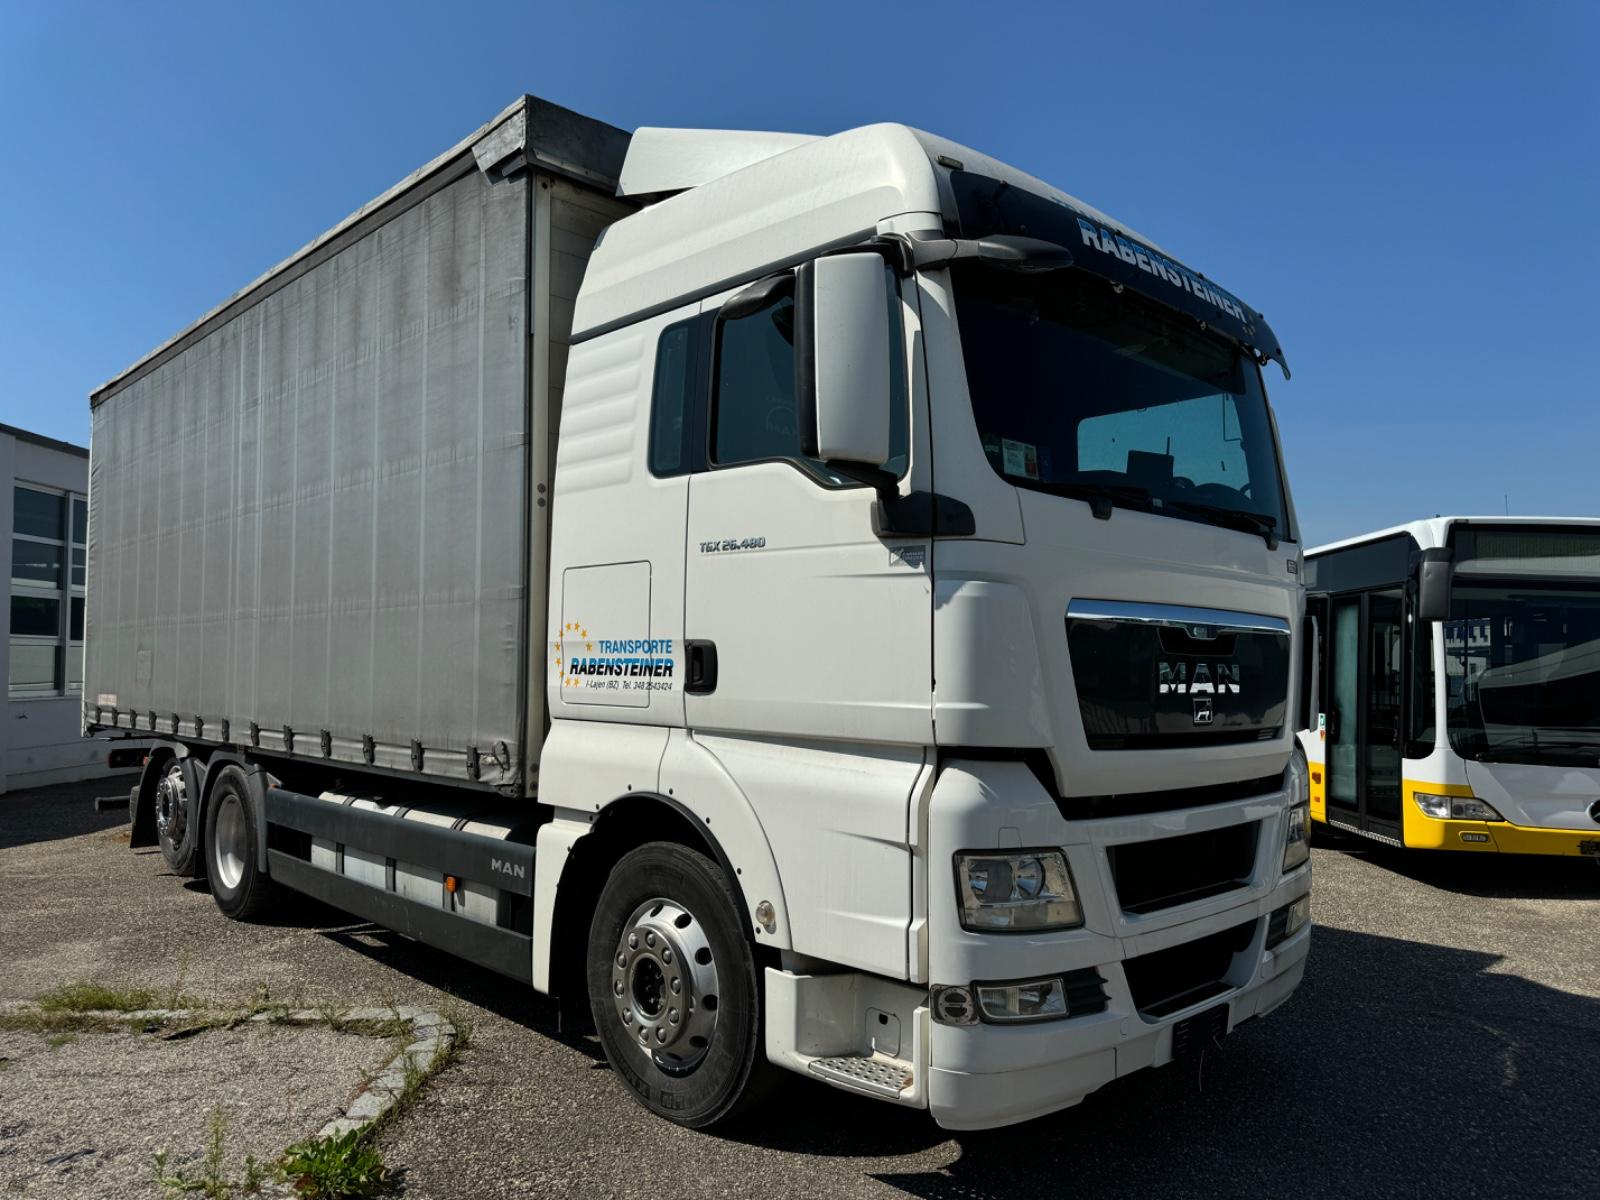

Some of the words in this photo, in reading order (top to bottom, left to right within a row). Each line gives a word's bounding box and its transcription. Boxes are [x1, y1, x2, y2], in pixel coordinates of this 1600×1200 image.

[1076, 217, 1248, 324] RABENSTEINER
[699, 541, 721, 553] TGX
[722, 536, 766, 551] 26.480
[599, 639, 673, 654] TRANSPORTE
[569, 657, 674, 677] RABENSTEINER
[1158, 661, 1241, 694] MAN
[491, 858, 525, 879] MAN
